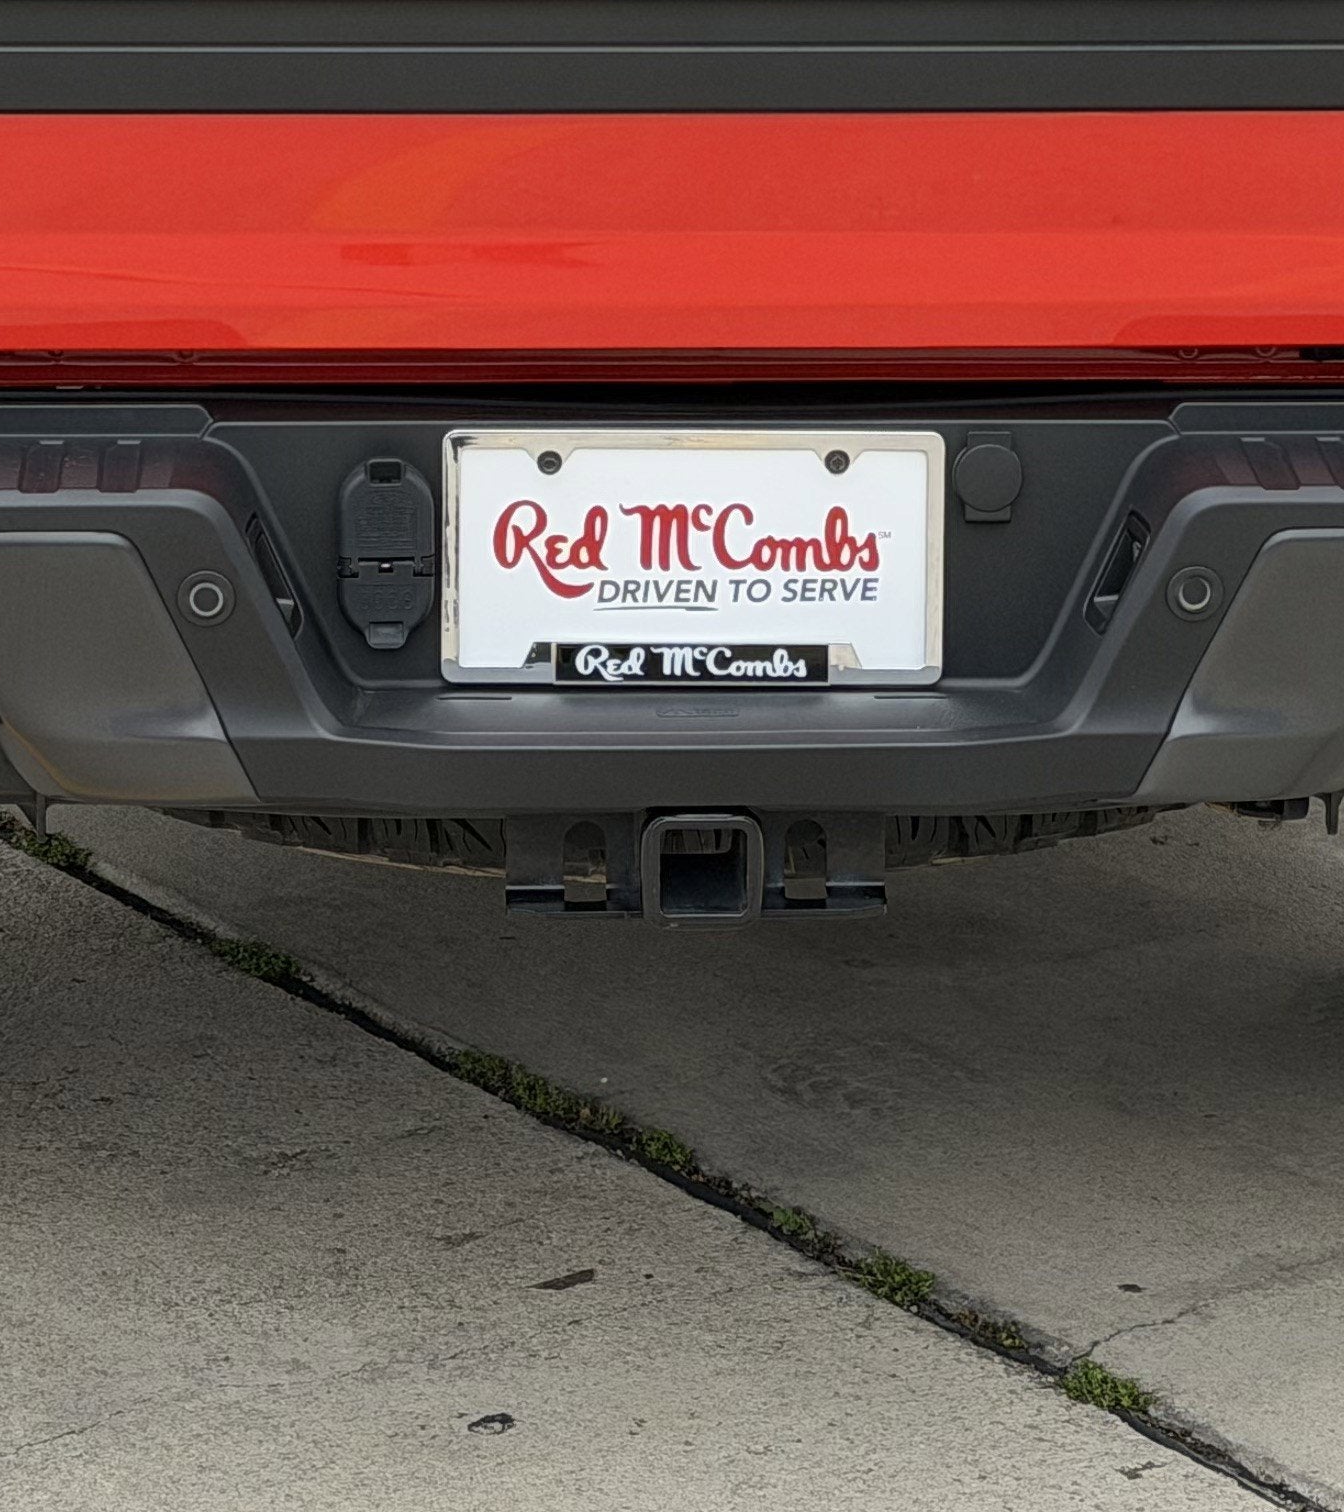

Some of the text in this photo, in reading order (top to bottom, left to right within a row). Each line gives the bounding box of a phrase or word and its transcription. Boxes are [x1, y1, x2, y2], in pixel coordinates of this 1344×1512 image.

[493, 500, 609, 599] Red
[619, 503, 880, 572] McCombs
[597, 578, 880, 604] DRIVEN TO SERVE
[575, 644, 808, 682] Red McCombs
